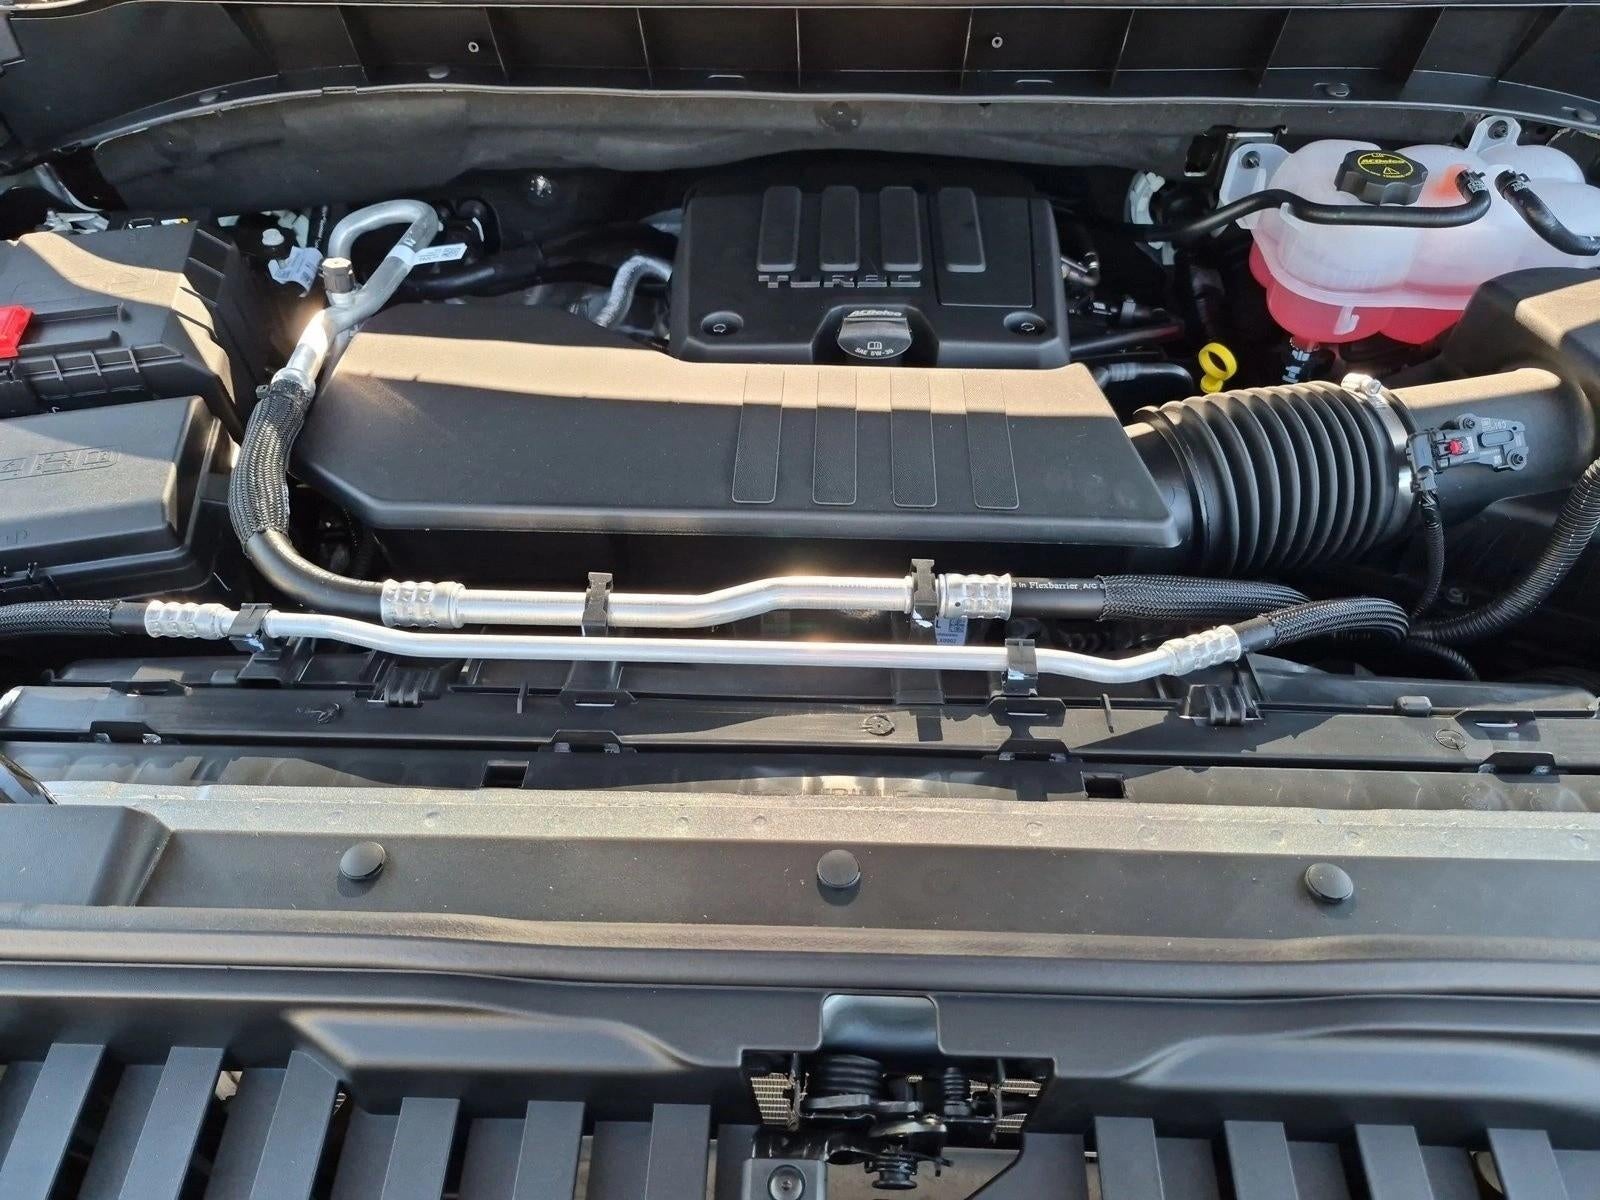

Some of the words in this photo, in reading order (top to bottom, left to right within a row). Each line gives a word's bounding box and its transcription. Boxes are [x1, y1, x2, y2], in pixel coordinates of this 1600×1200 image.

[847, 309, 903, 319] ACDelco
[854, 347, 869, 356] SAE
[1028, 580, 1078, 590] Flexbarrier
